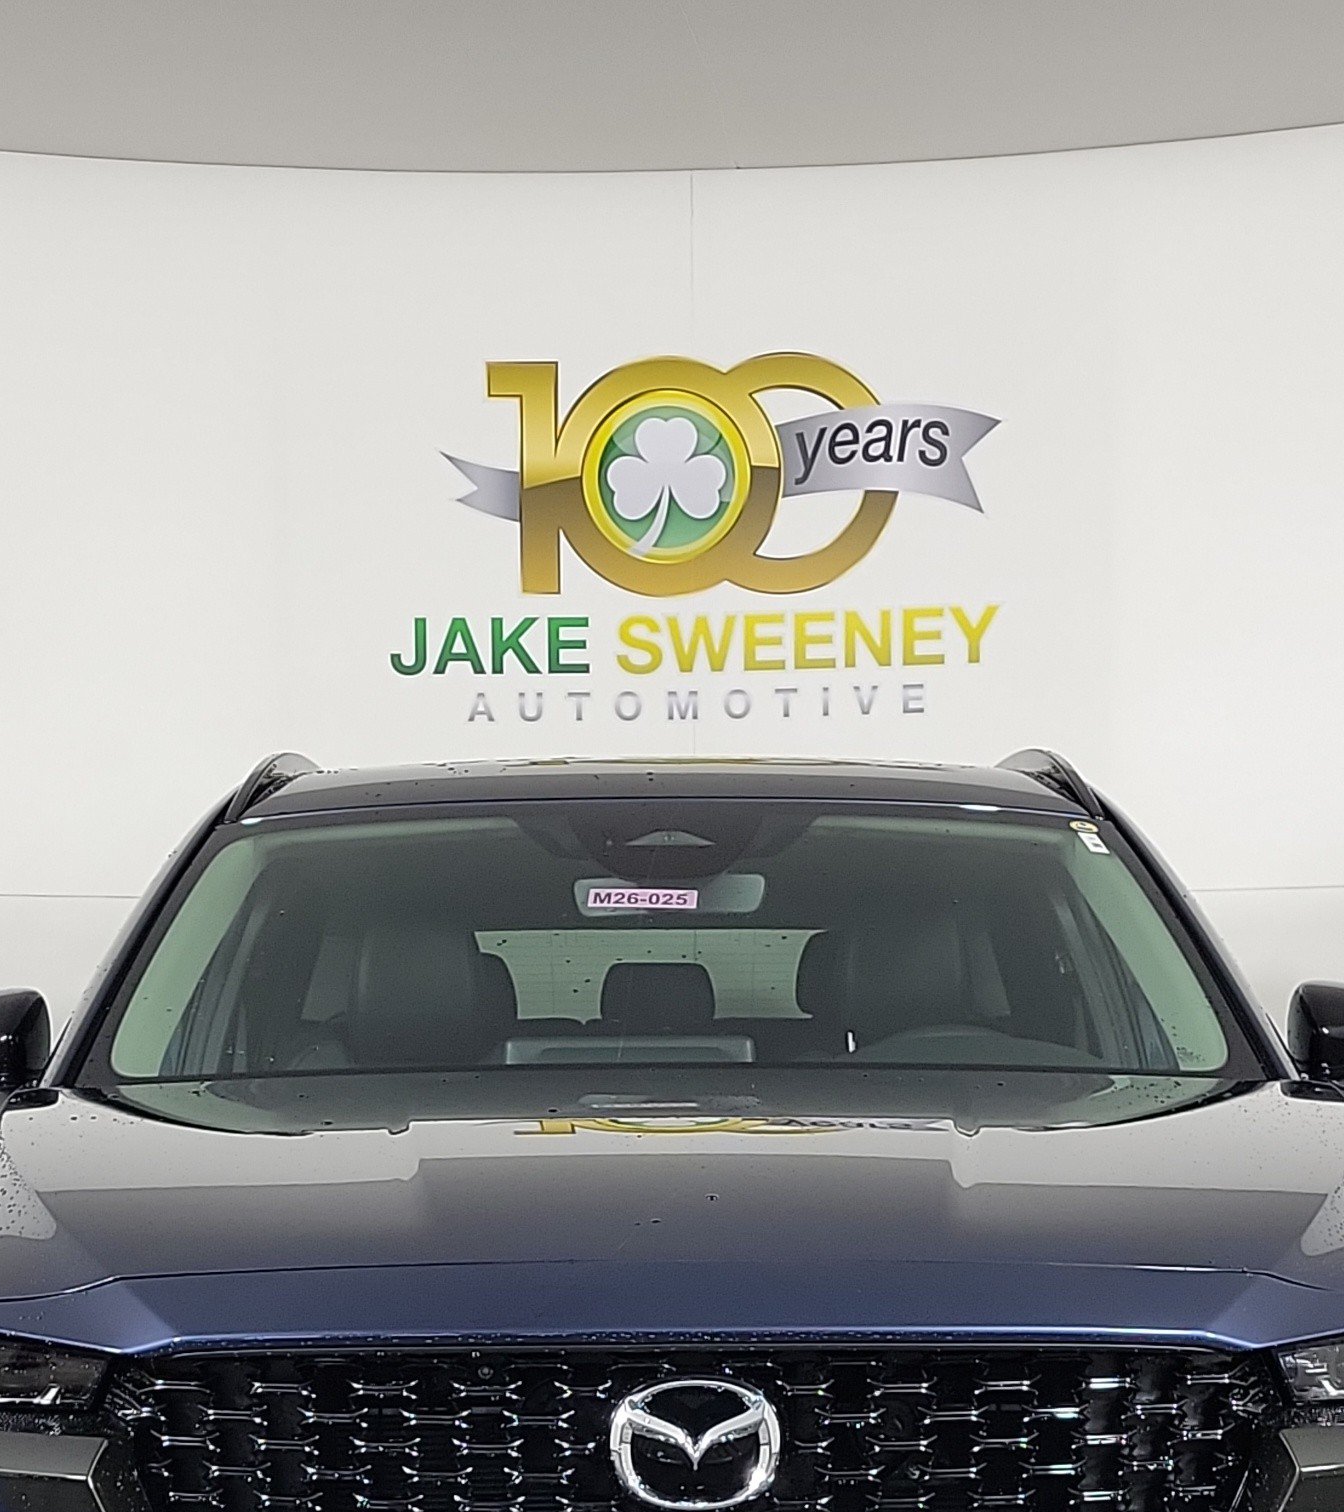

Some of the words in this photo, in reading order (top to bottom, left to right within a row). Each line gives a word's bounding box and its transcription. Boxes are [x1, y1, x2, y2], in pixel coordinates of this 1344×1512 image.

[485, 352, 899, 597] 100
[793, 418, 951, 487] years
[390, 615, 591, 677] JAKE
[616, 604, 1001, 676] SWEENEY
[467, 683, 926, 723] AUTOMOTIVE
[592, 891, 689, 907] M26-025
